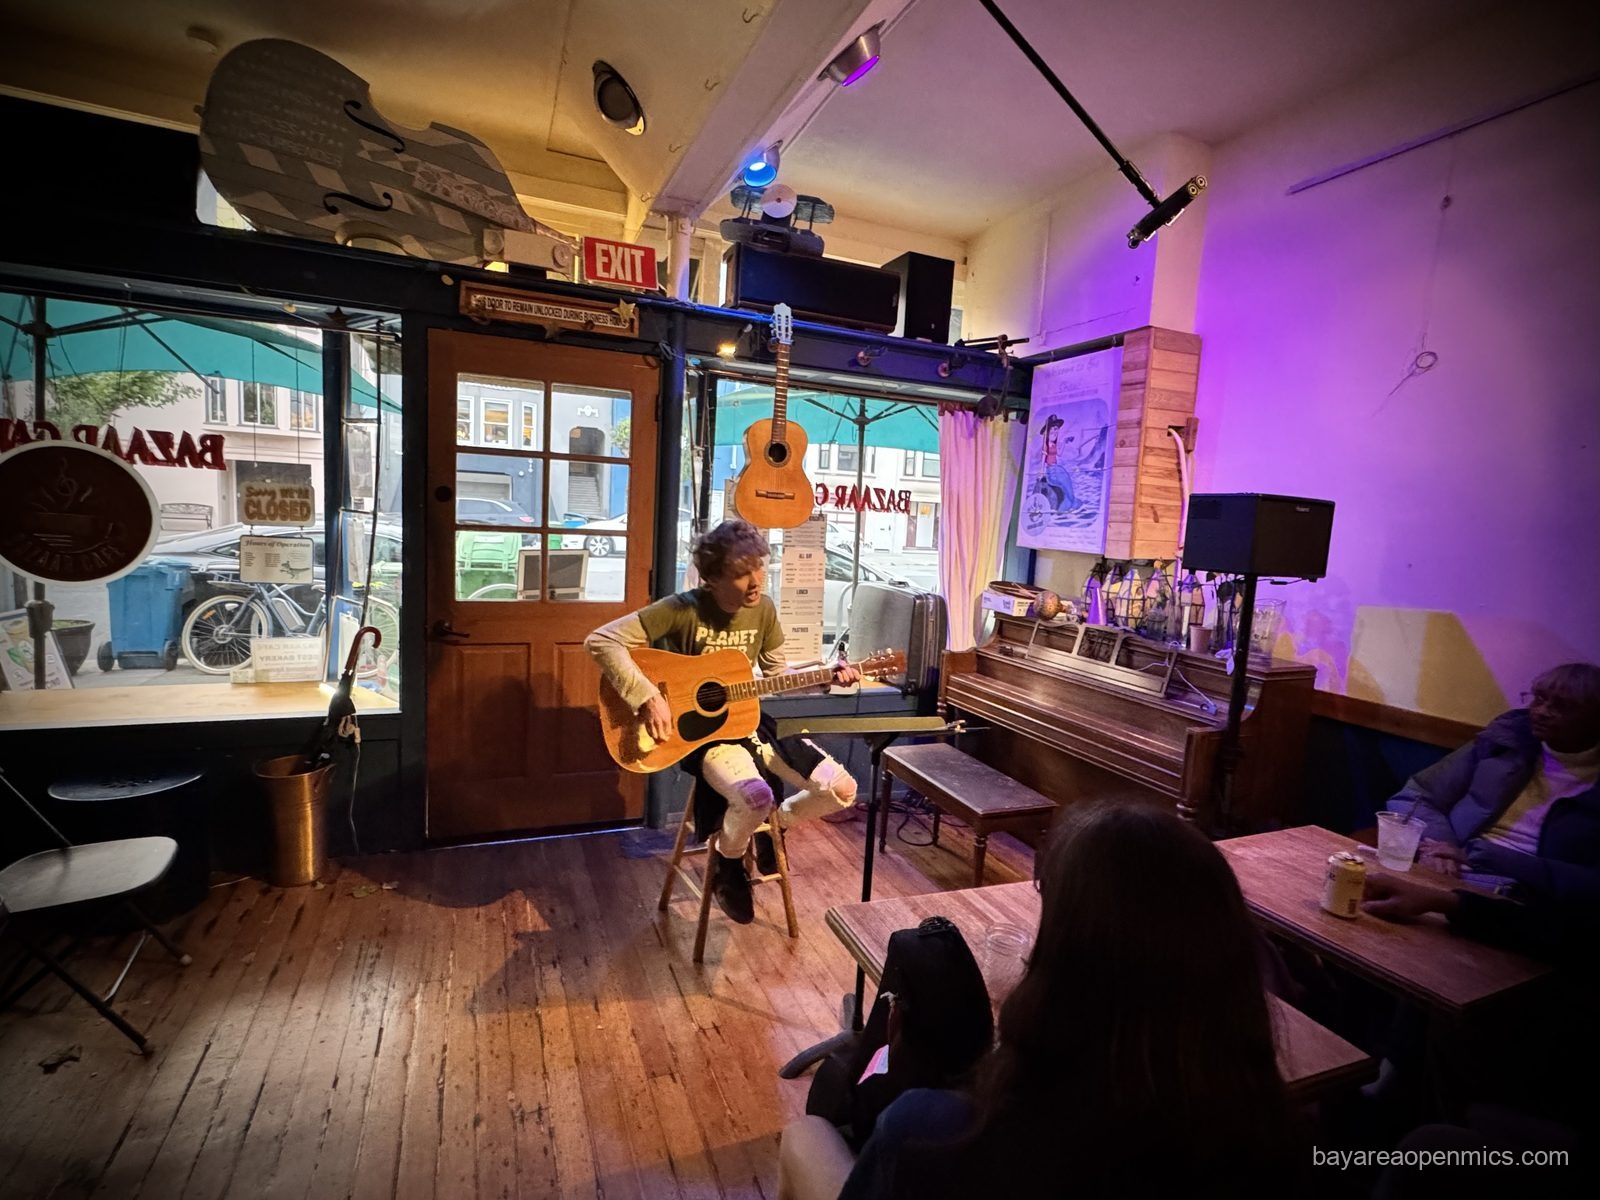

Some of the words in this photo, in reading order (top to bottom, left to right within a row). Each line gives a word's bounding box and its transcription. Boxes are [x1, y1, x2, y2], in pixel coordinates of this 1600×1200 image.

[595, 242, 645, 283] EXIT
[486, 297, 504, 310] DOOR
[504, 299, 513, 311] TO
[512, 301, 534, 315] REMAIN
[534, 304, 562, 319] UNLOCKED
[563, 308, 584, 321] DURING
[584, 311, 609, 325] BUSINESS
[245, 486, 277, 501] Sorry
[244, 498, 312, 522] CLOSED
[244, 540, 266, 548] Hours
[267, 541, 276, 549] of
[276, 541, 311, 549] Operation
[695, 626, 759, 646] PLANET
